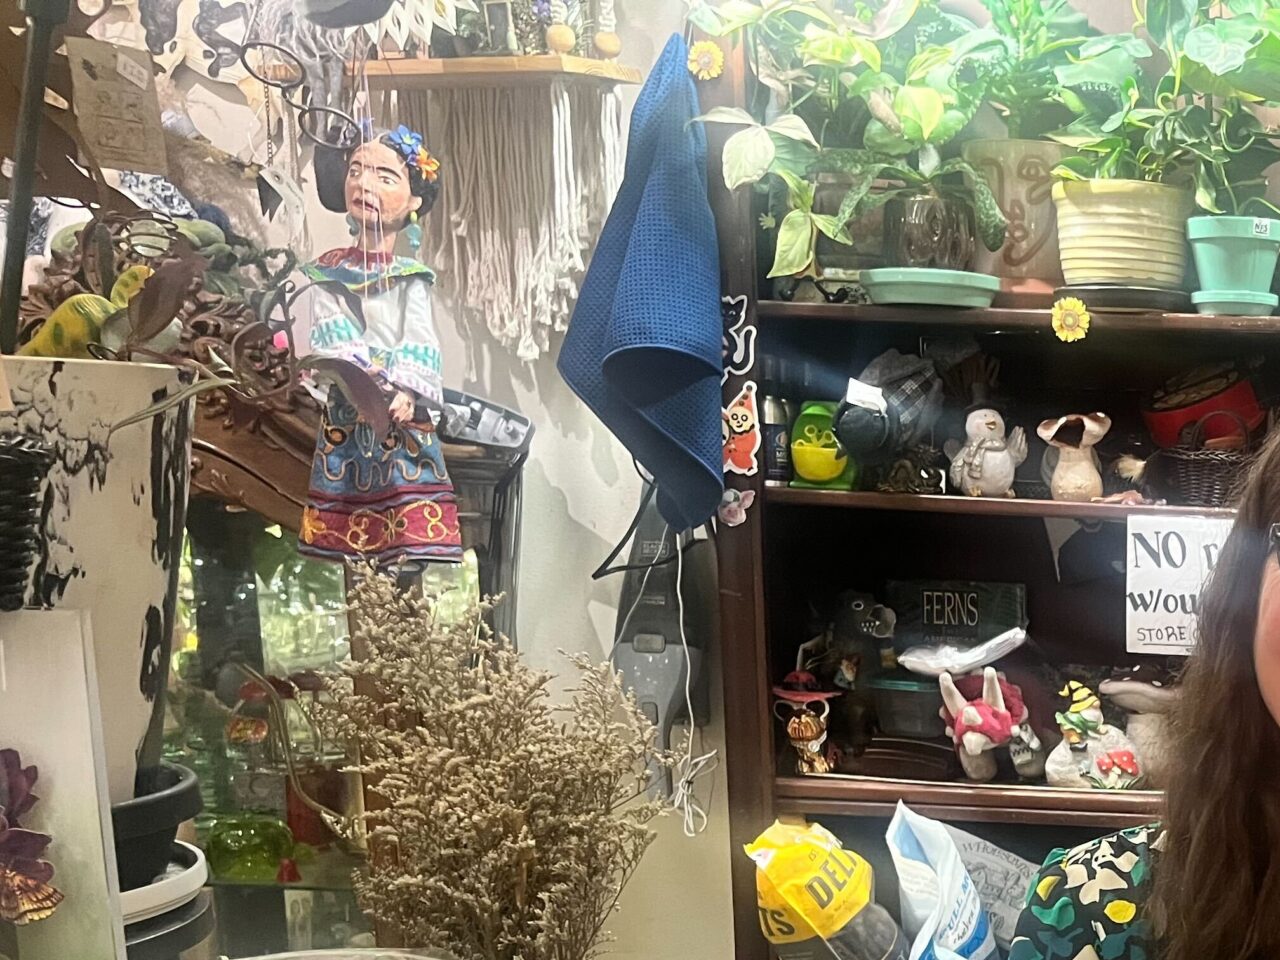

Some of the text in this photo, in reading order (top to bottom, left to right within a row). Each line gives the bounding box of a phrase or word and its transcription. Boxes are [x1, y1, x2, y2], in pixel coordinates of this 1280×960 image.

[1131, 531, 1187, 568] NO
[923, 591, 979, 626] FERNS
[1126, 588, 1200, 615] w/ou
[1137, 626, 1187, 641] STORE
